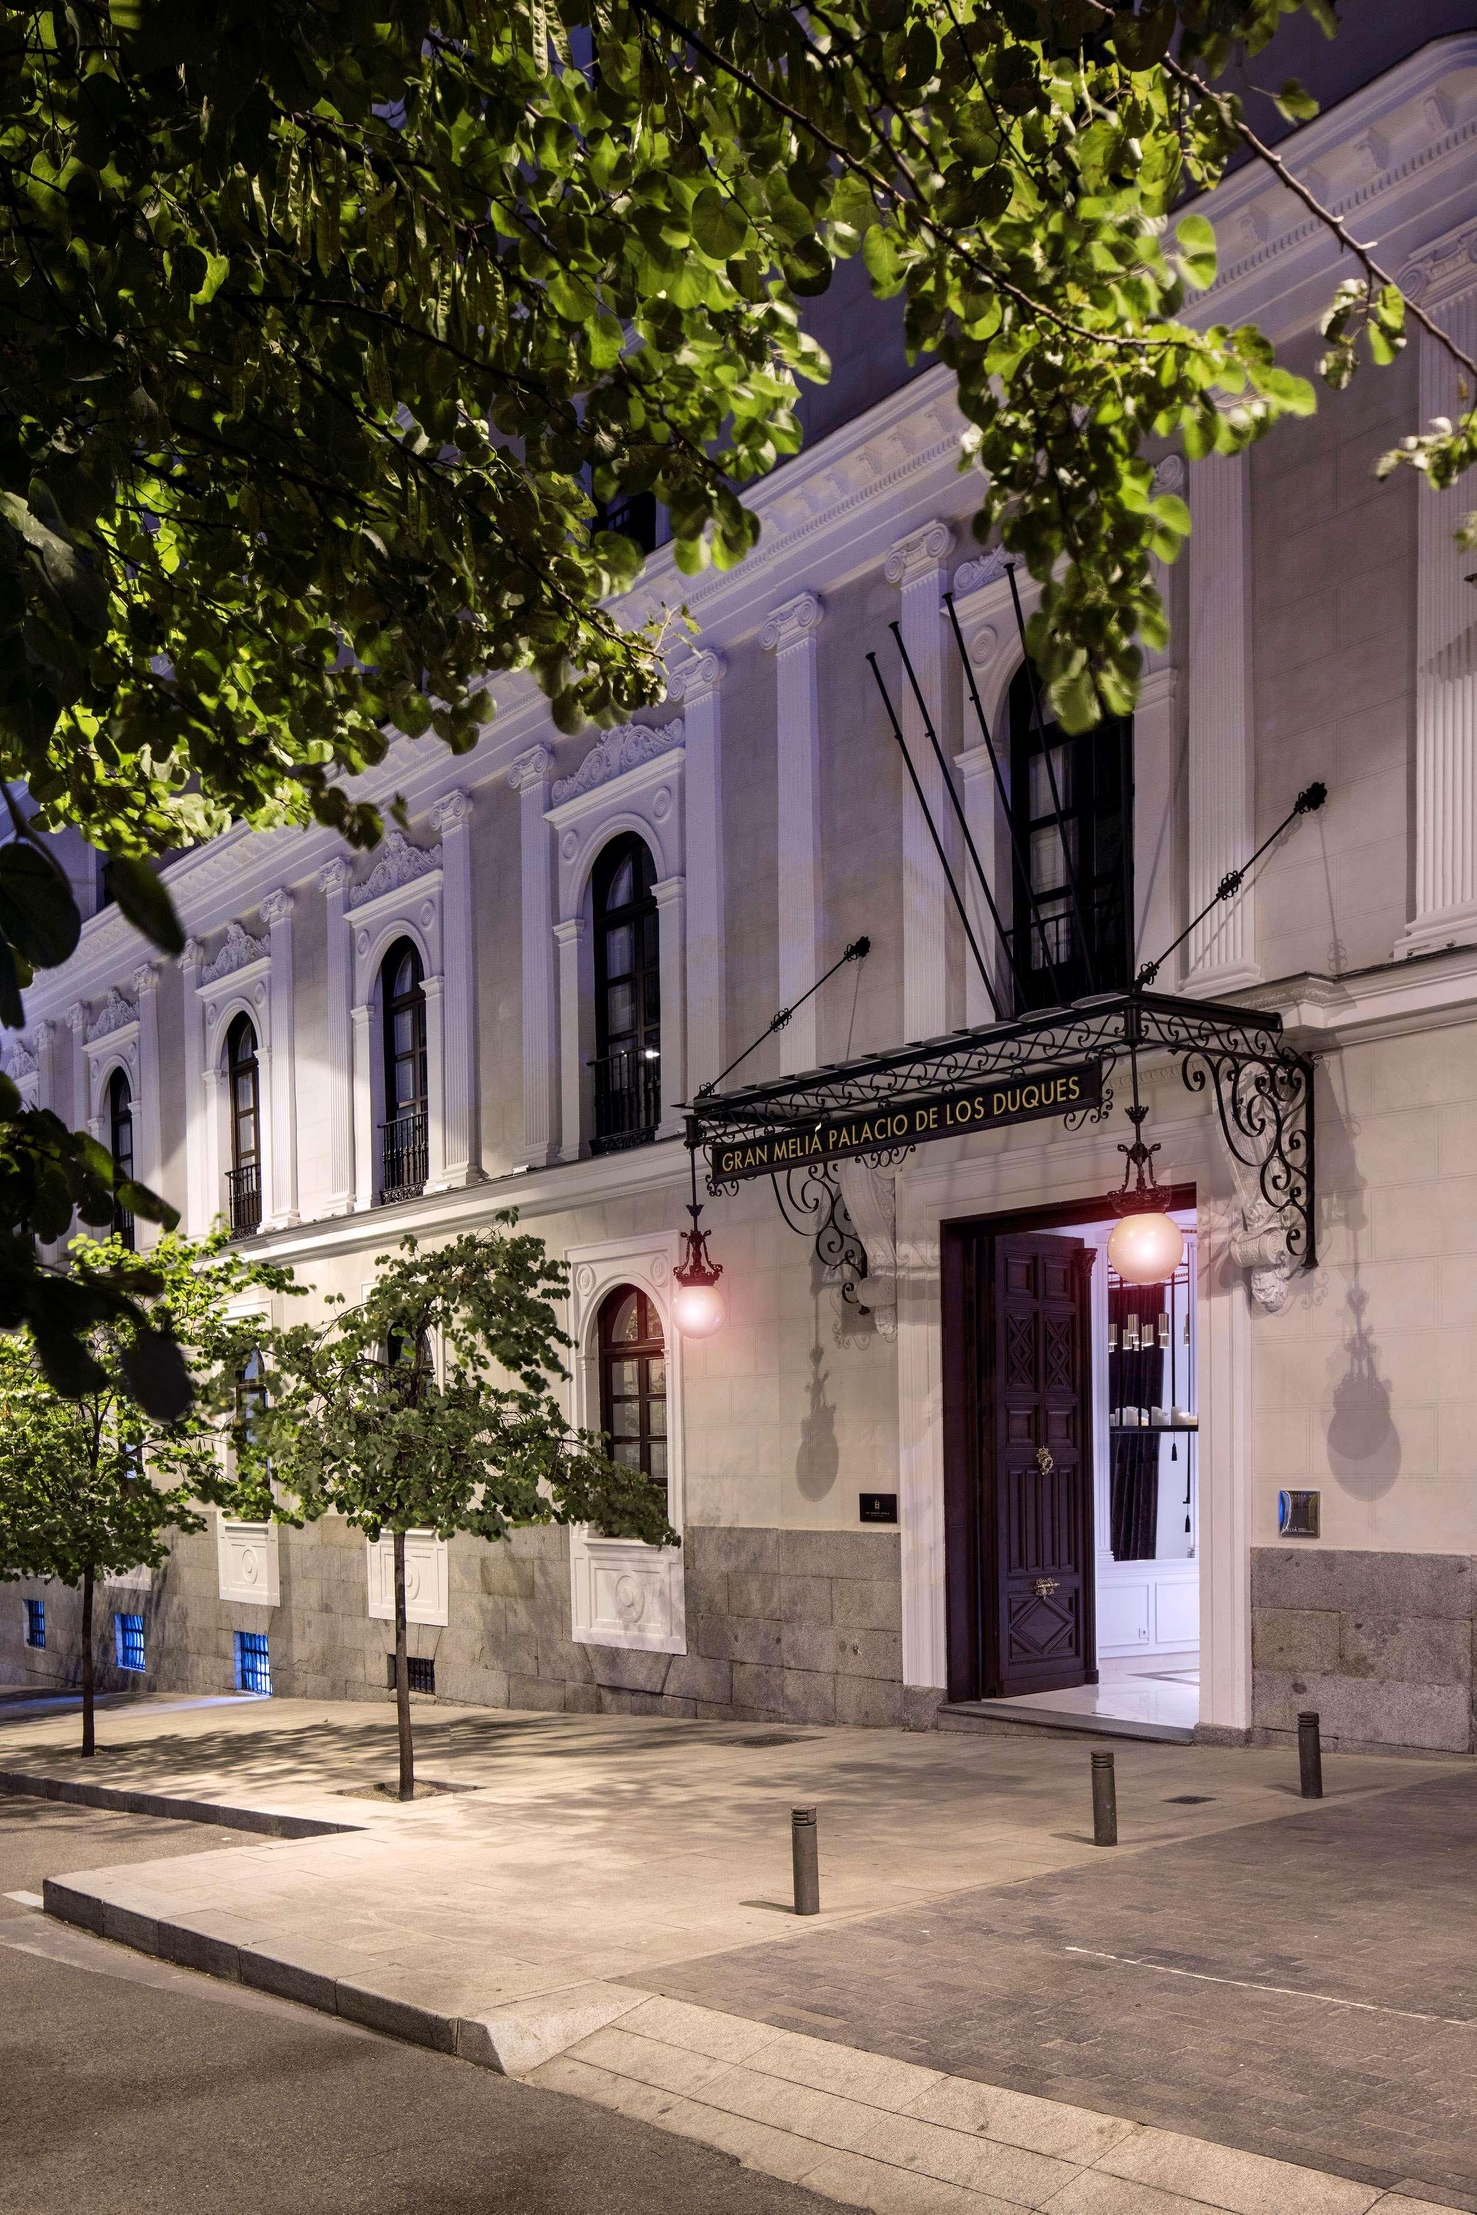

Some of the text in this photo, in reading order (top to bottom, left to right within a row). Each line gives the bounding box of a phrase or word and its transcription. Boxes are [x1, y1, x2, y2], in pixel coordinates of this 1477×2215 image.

[722, 1076, 1080, 1172] GRAN MELIÁ PALACIO DE LOS DUQUES
